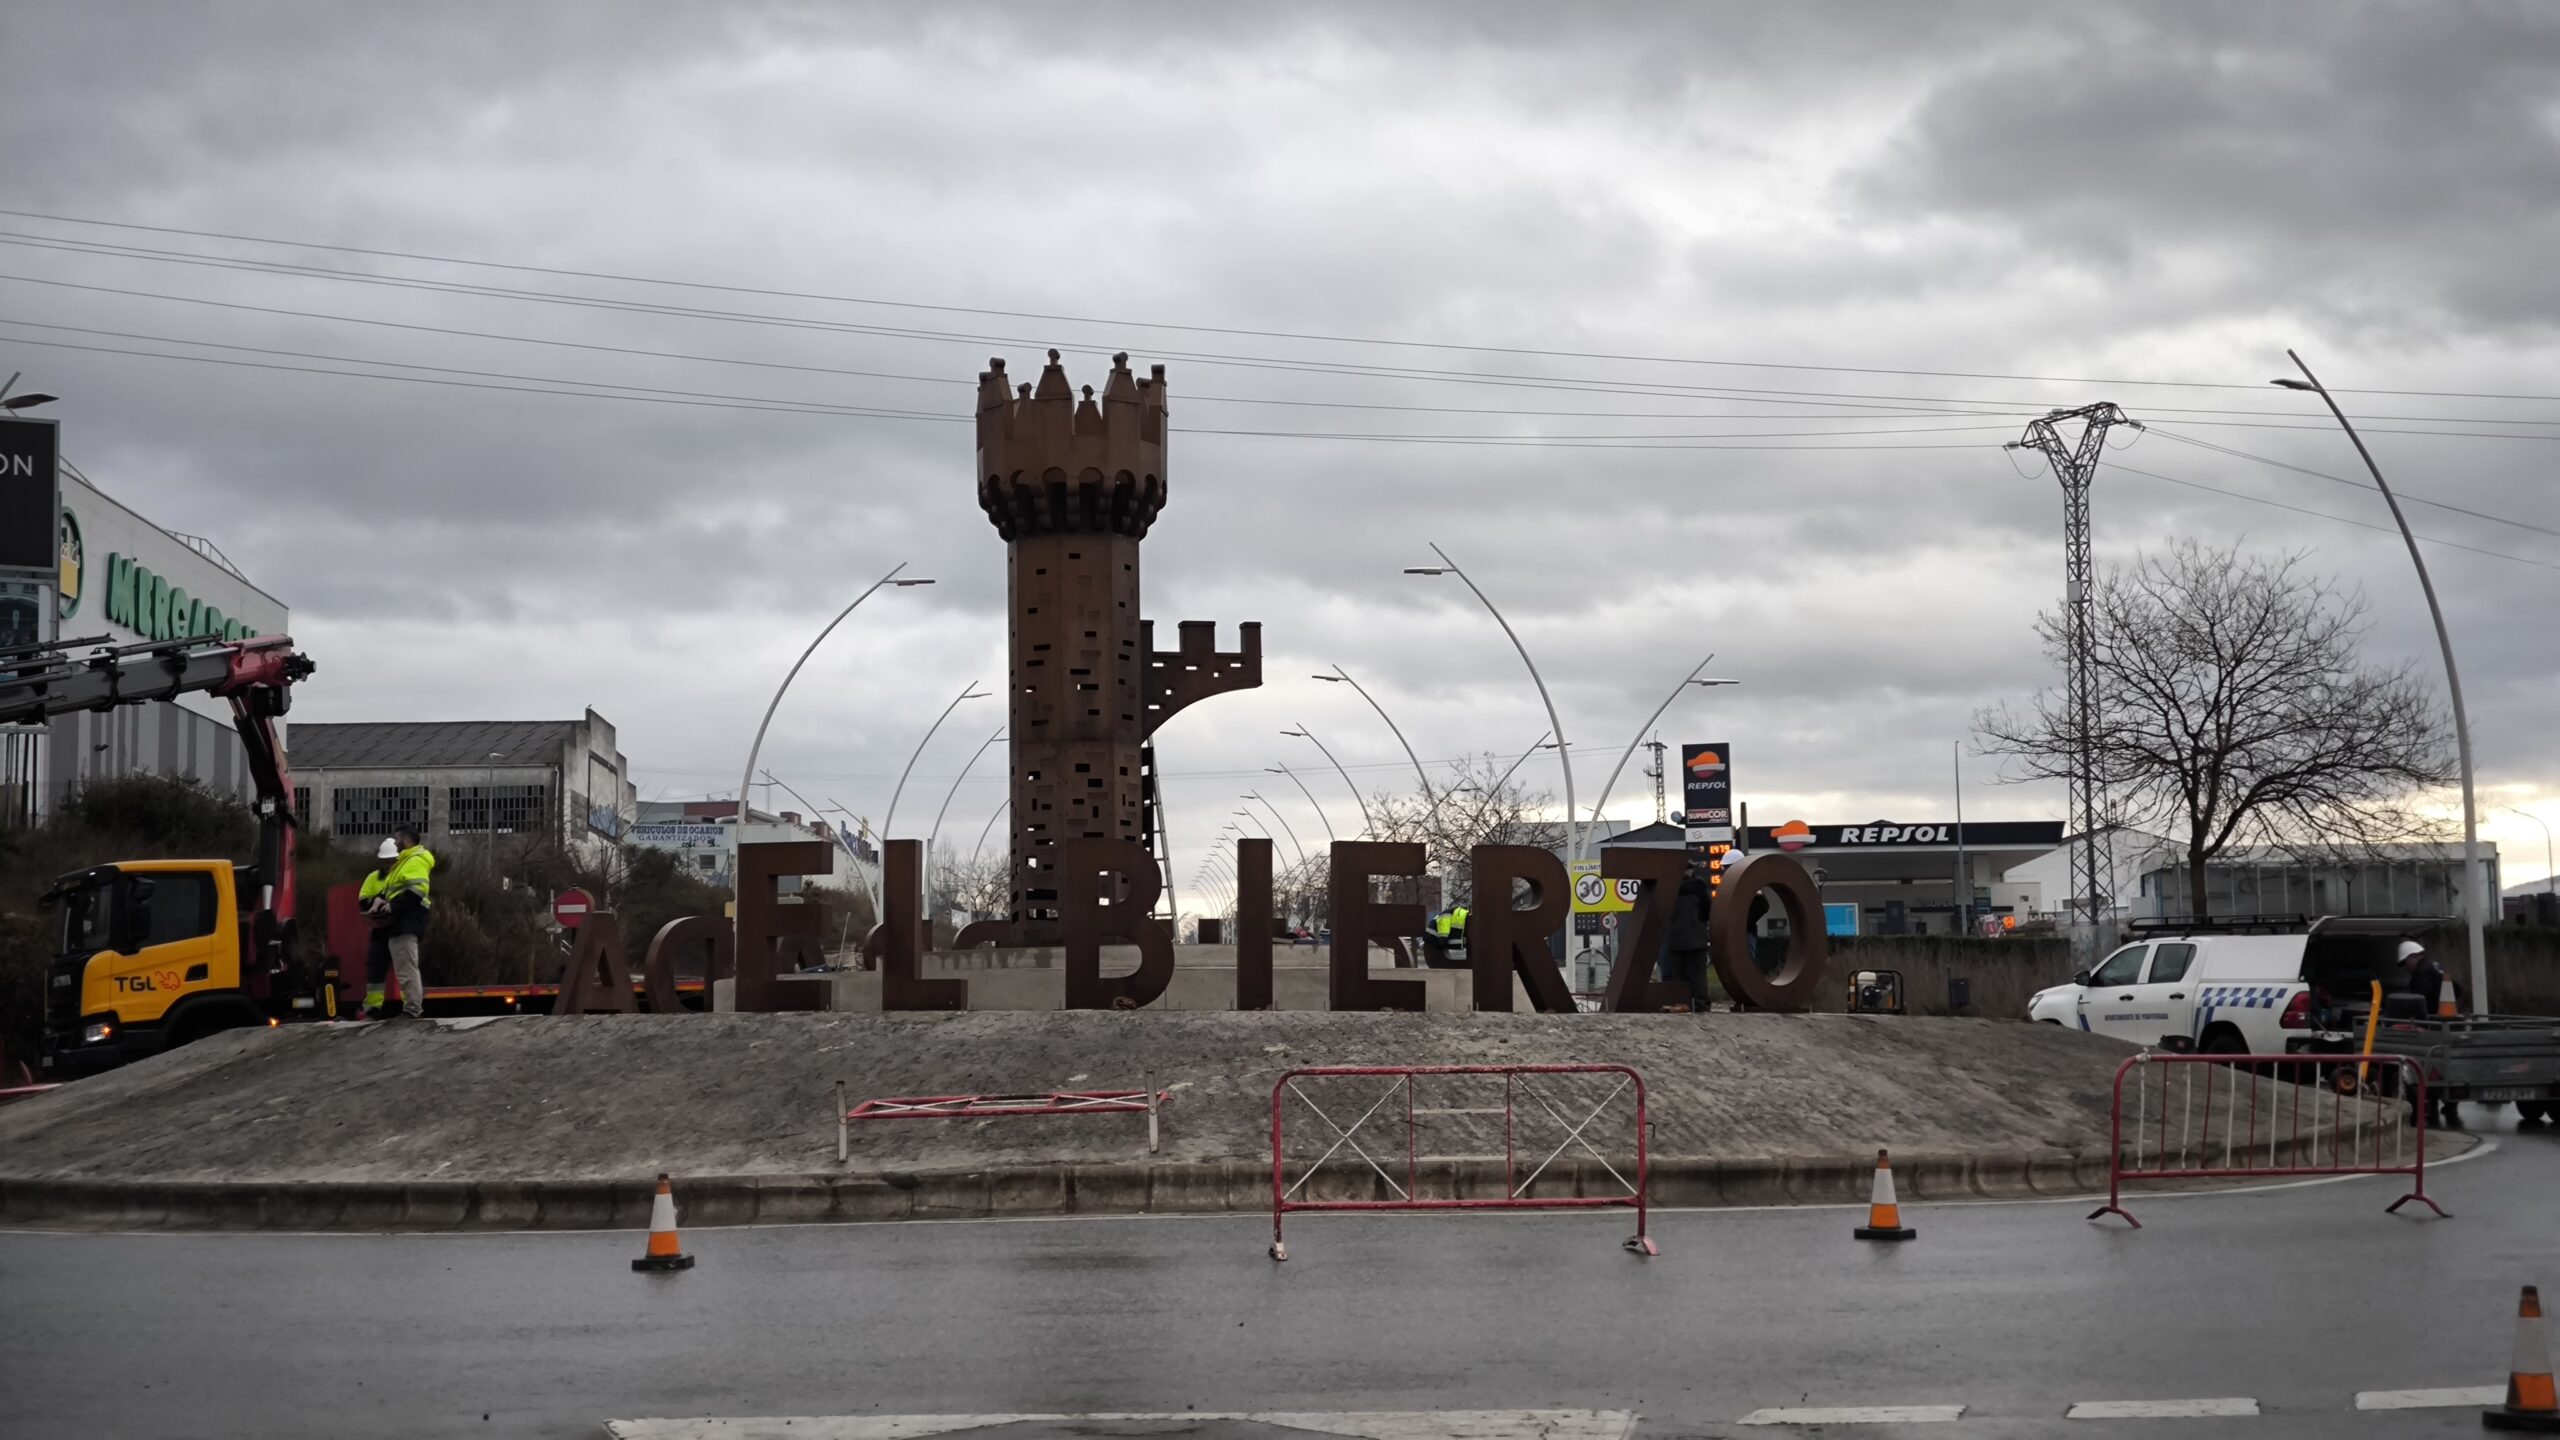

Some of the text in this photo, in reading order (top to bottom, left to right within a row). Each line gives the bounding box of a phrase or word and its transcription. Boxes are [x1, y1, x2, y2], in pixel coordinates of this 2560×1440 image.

[1687, 781, 1727, 790] REPSOL
[631, 825, 676, 835] VEHICULOS
[677, 826, 688, 835] DE
[638, 834, 712, 842] GARANTIZADOS
[1840, 826, 1950, 843] REPSOL
[1580, 880, 1603, 898] 30
[1620, 880, 1639, 896] 50
[735, 839, 968, 1012] EL
[1066, 838, 1828, 1013] BIERZO
[114, 976, 157, 992] TGL
